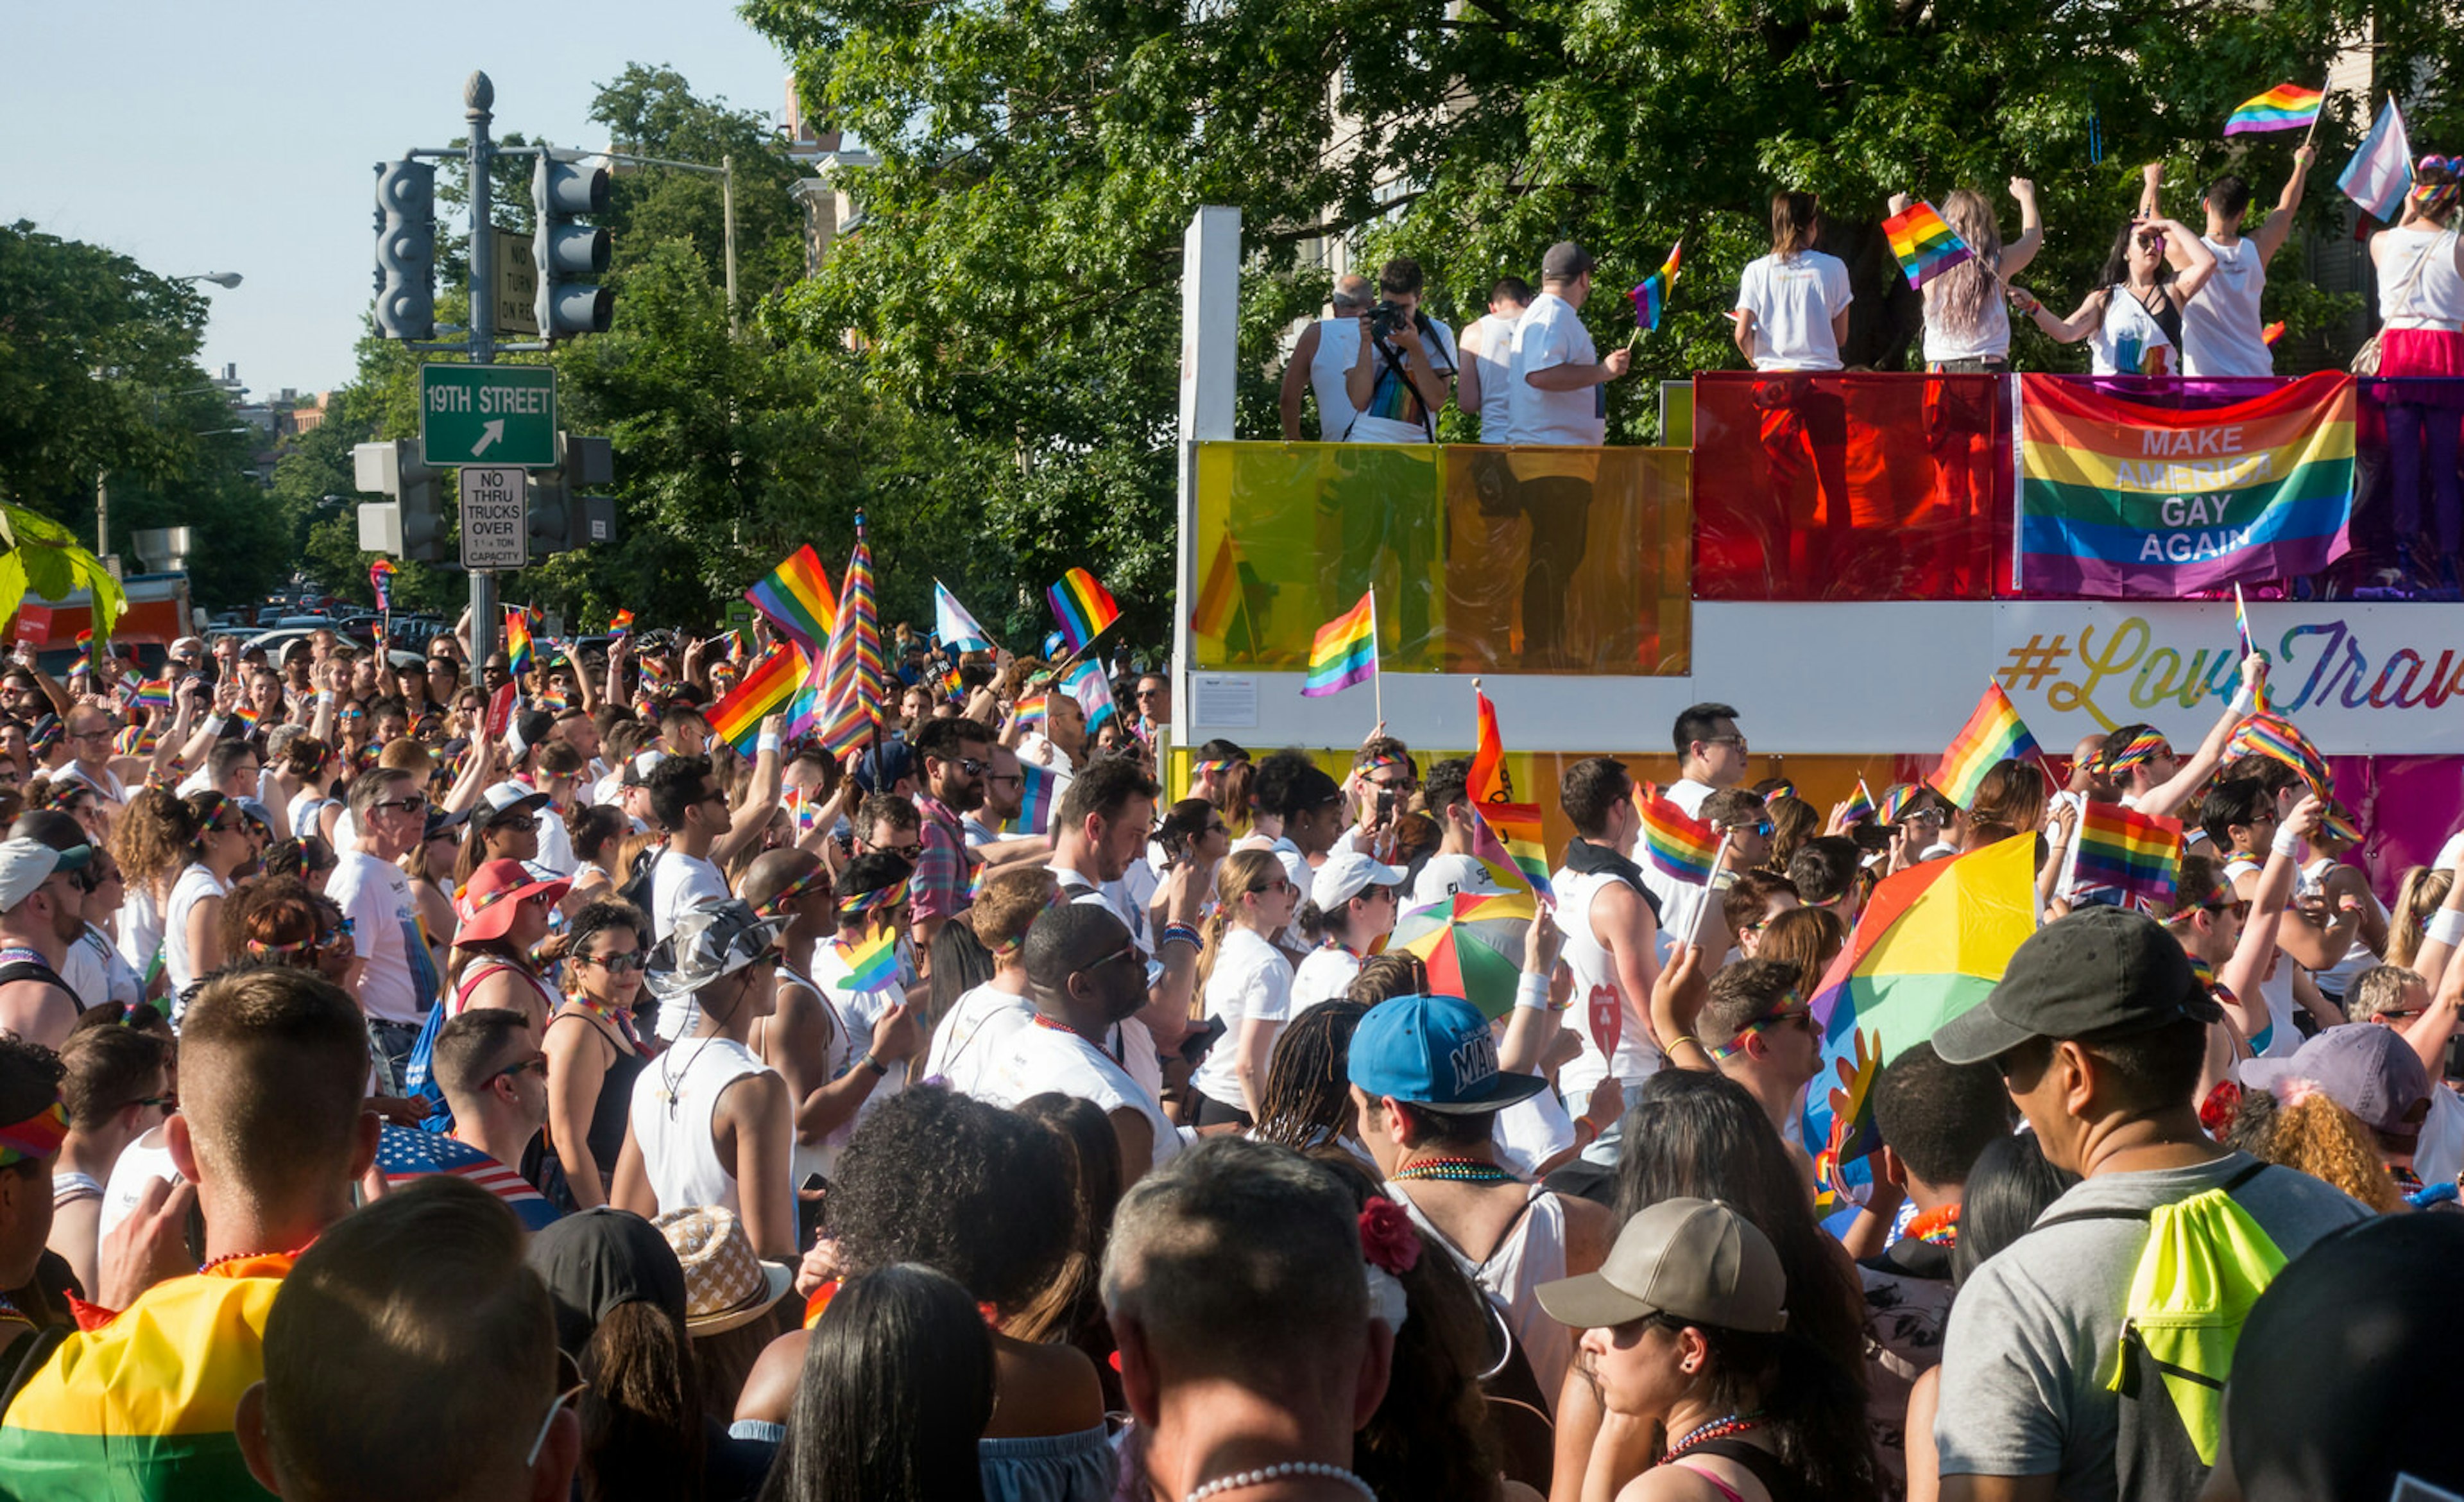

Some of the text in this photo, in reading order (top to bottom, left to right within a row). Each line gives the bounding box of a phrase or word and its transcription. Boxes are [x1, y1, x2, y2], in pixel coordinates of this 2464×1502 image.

[511, 246, 527, 265] NO
[506, 272, 532, 294] TURN
[501, 300, 516, 319] ON
[426, 384, 551, 414] 19TH STREET
[2142, 426, 2243, 456] MAKE
[481, 472, 504, 487] NO
[2114, 452, 2273, 490] AMERICA
[472, 490, 513, 503] THRU
[468, 505, 520, 519] TRUCKS
[2161, 494, 2232, 527] GAY
[472, 522, 513, 535] OVER
[496, 538, 515, 548] TON
[2139, 526, 2251, 562] AGAIN
[470, 551, 520, 562] CAPACITY
[1450, 1033, 1498, 1096] MAG
